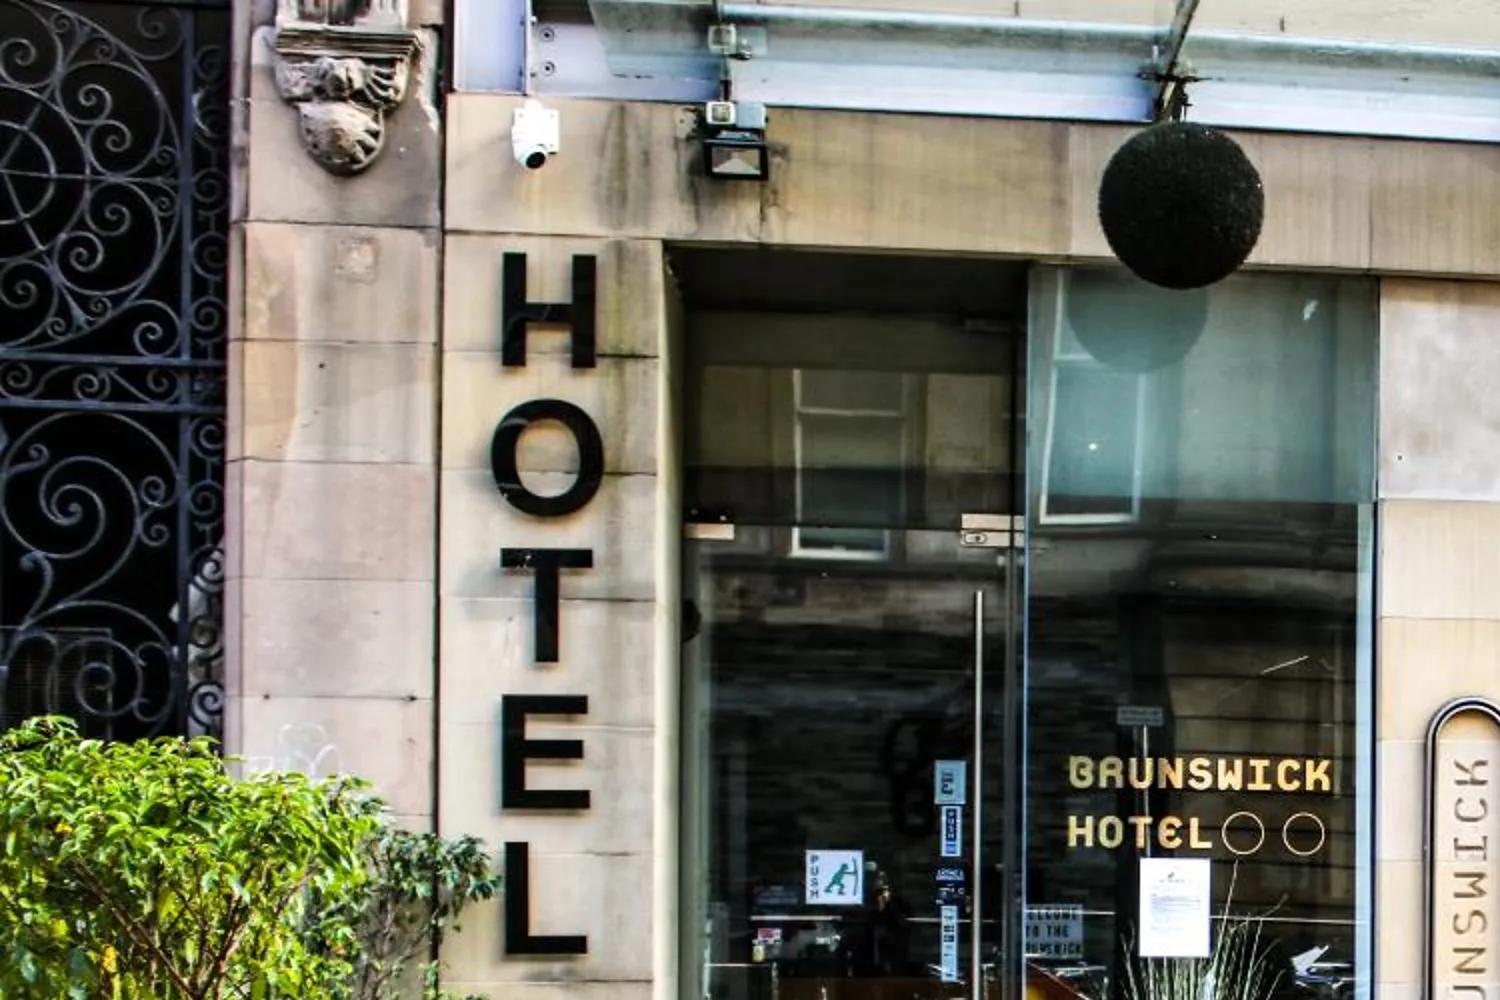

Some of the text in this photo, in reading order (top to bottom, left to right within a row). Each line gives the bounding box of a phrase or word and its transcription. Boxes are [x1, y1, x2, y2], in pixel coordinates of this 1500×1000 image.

[491, 252, 602, 955] HOTEL
[1069, 755, 1332, 792] BRUNSWICK
[1066, 815, 1213, 849] HOTEL
[810, 854, 820, 899] PUSH
